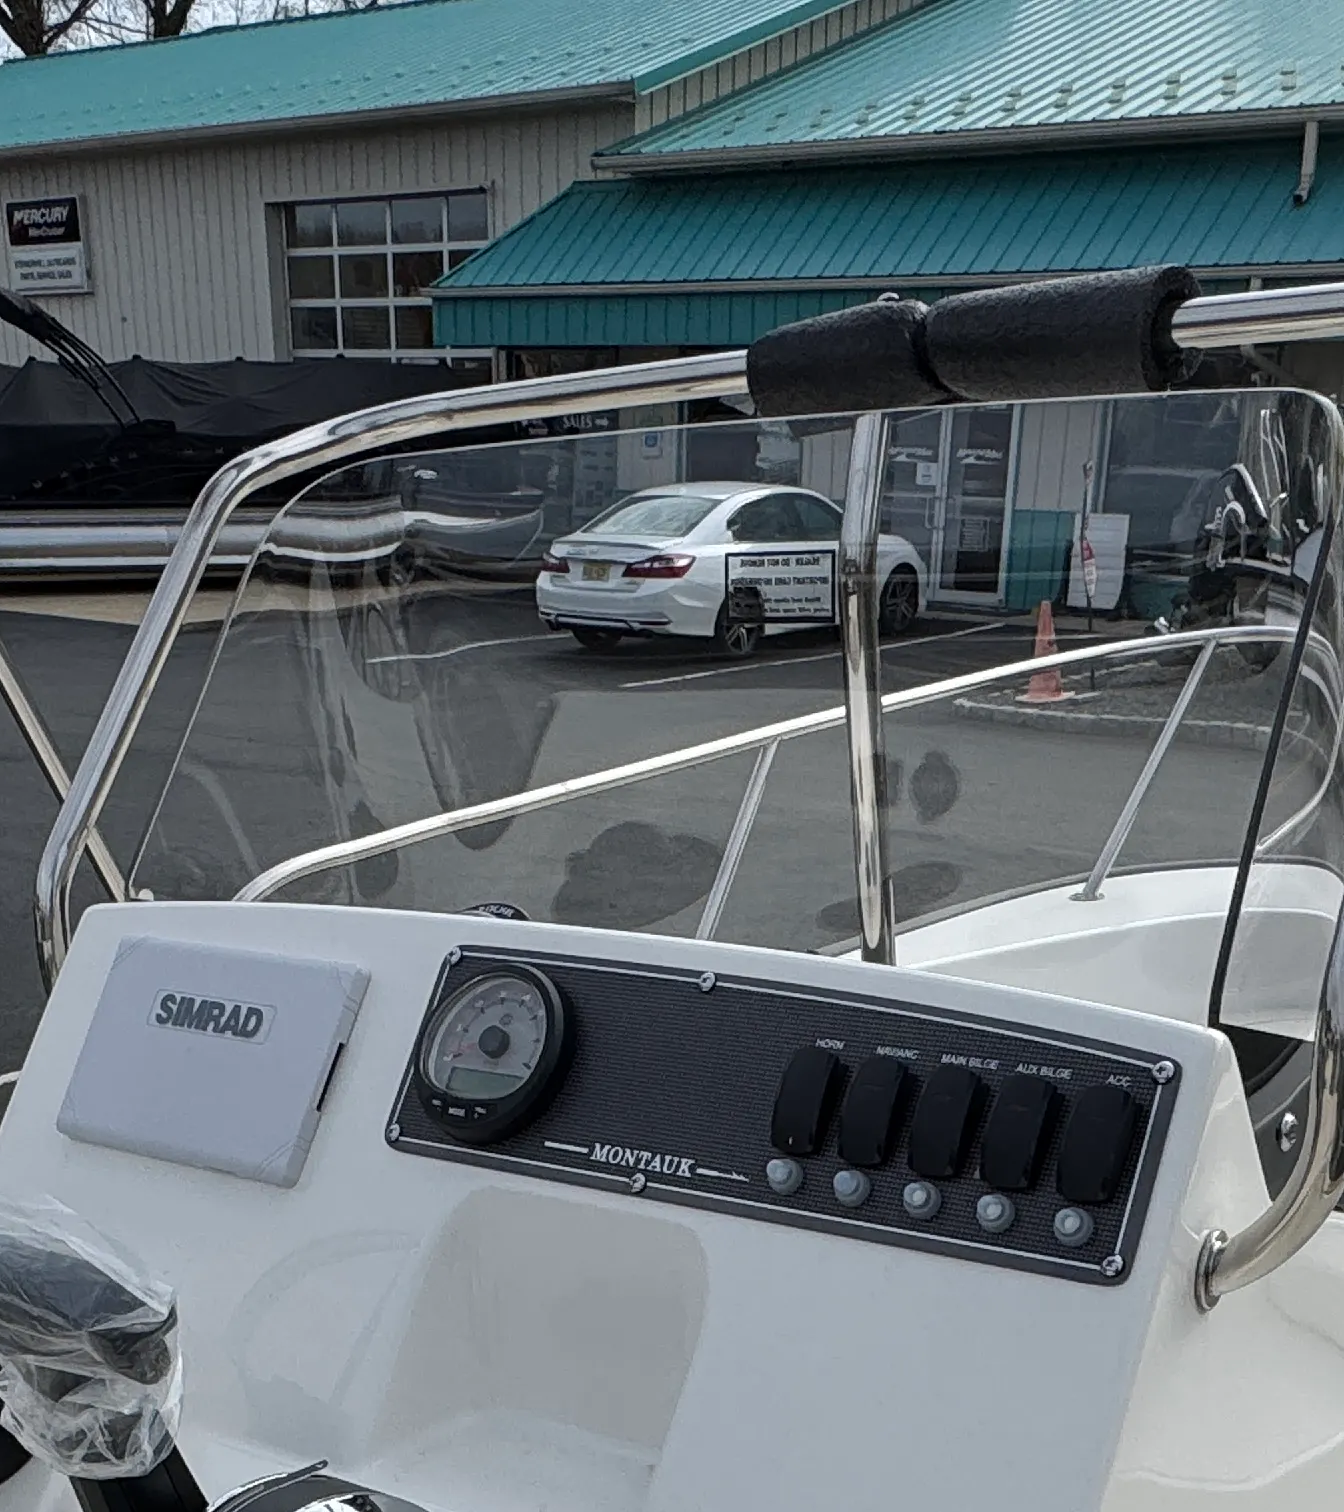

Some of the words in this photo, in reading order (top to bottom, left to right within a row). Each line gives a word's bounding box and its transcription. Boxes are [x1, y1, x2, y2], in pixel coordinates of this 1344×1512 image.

[13, 205, 69, 225] MERCURY
[155, 992, 265, 1040] SIMRAD
[814, 1037, 846, 1050] HORN
[939, 1053, 967, 1068] MAIN
[968, 1055, 1000, 1070] BILGE
[1015, 1061, 1038, 1076] AUX
[1039, 1065, 1073, 1080] BILGE
[1104, 1073, 1133, 1088] ACC
[589, 1140, 698, 1180] MONTAUK
